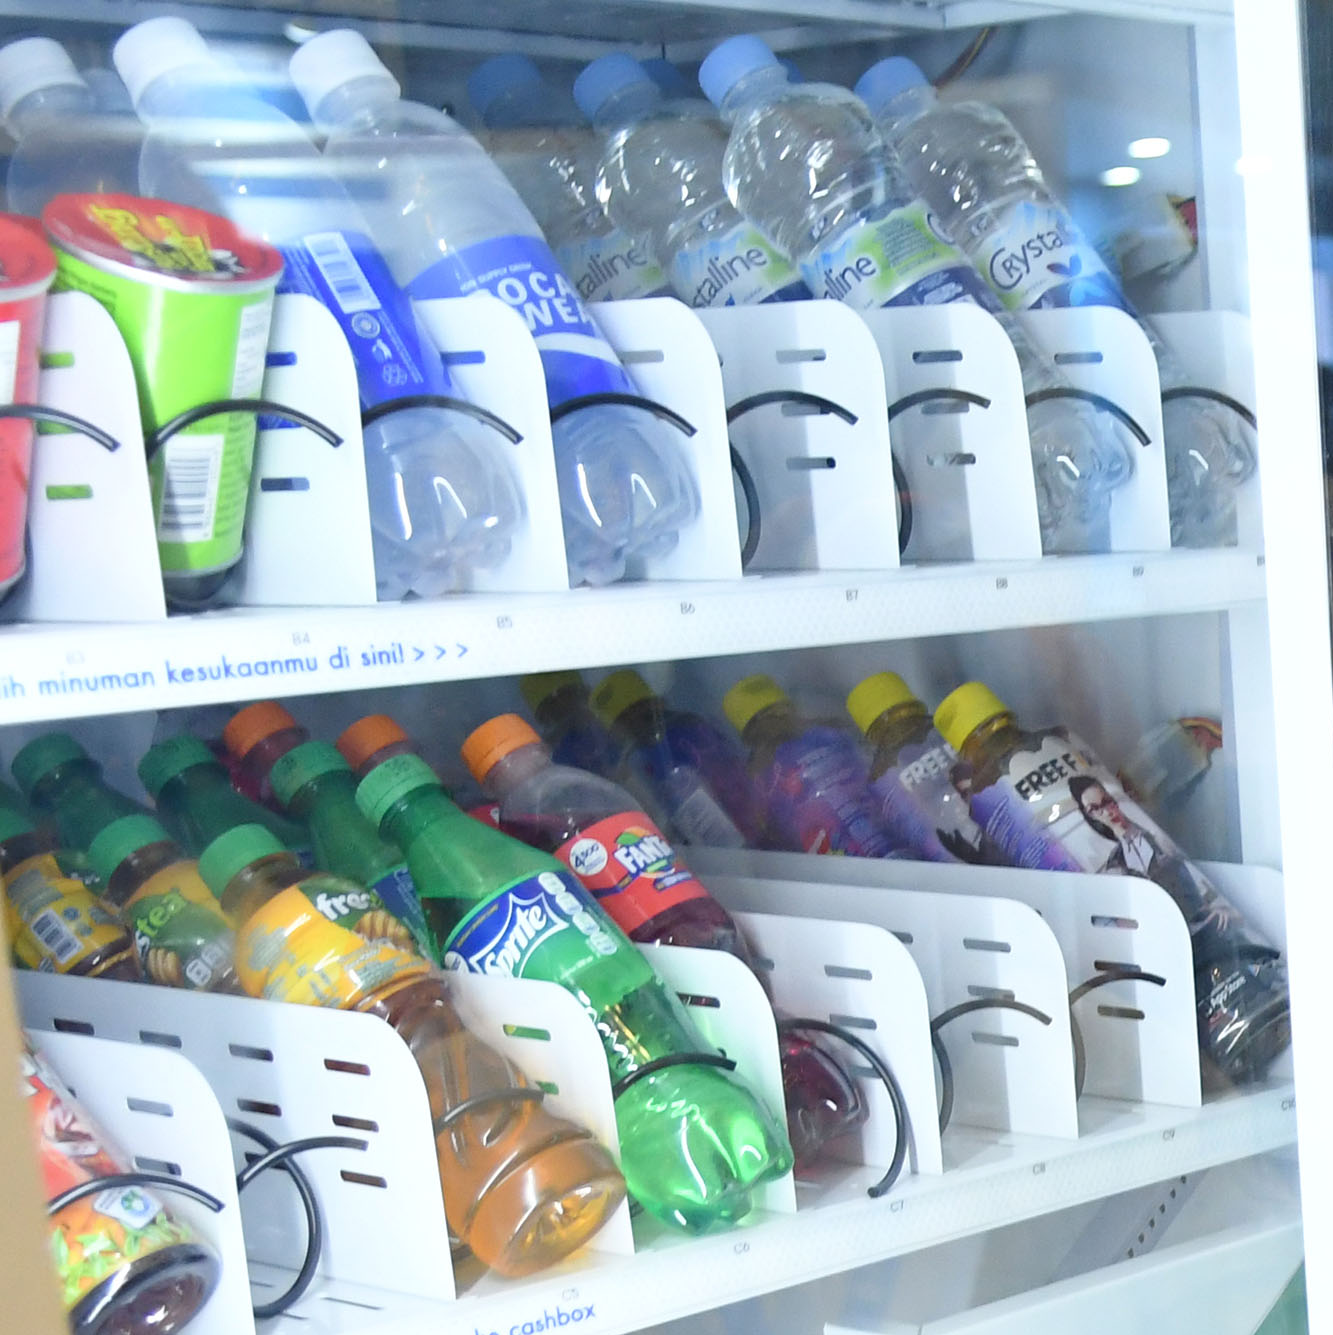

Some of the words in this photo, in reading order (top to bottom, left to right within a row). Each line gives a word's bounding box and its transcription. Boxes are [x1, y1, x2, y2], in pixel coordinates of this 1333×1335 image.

[39, 667, 155, 696] minuman
[165, 653, 319, 685] kesukaanmu
[328, 646, 351, 670] di
[361, 642, 405, 668] sini!
[1015, 758, 1066, 800] FREE
